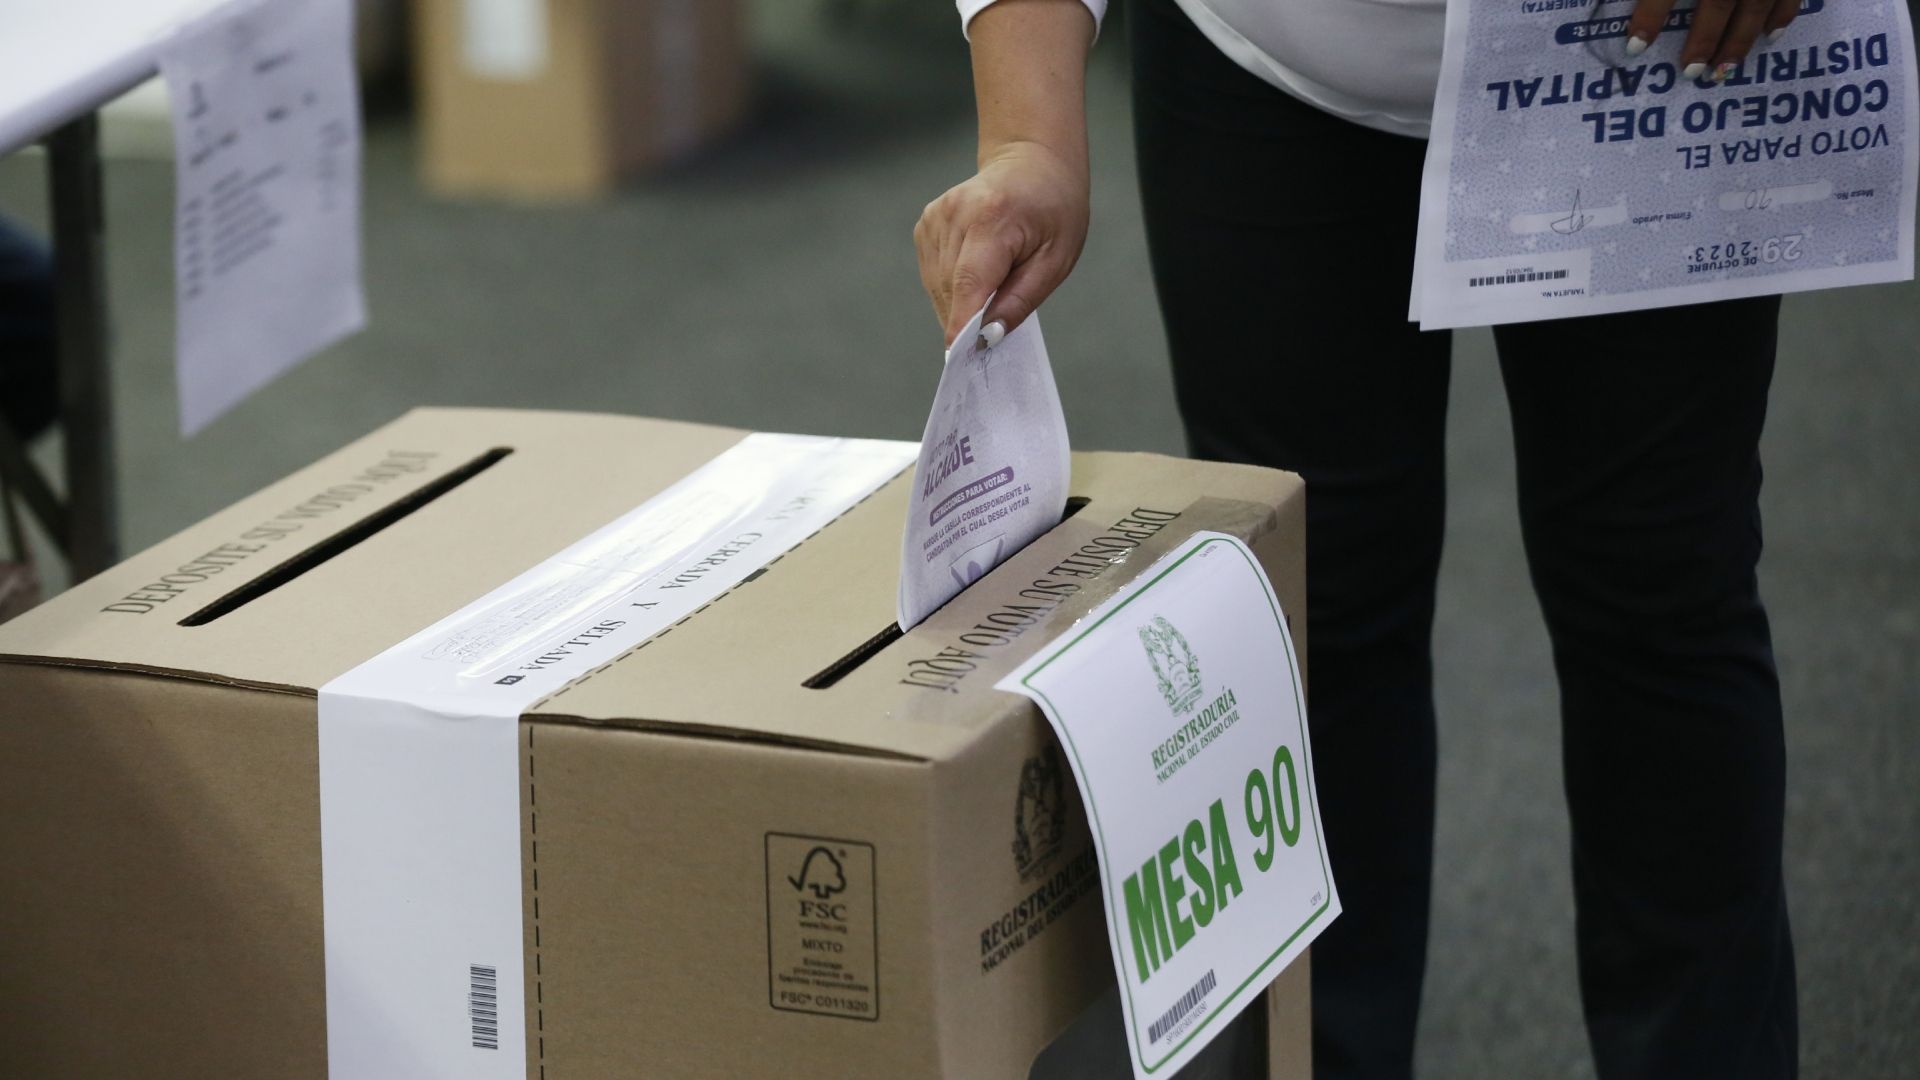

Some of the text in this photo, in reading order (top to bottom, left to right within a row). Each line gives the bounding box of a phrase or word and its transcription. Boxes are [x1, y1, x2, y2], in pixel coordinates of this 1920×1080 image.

[1573, 19, 1630, 37] VOTAR:
[1487, 62, 1676, 111] CAPITAL
[1582, 79, 1889, 143] CONCEJO DEL
[1676, 123, 1889, 169] VOTO PARA EL
[1834, 189, 1874, 200] Mesa No.
[1632, 211, 1692, 224] Firma Jurado
[1687, 257, 1757, 273] DE OCTUBRE
[1762, 233, 1803, 263] 29
[1553, 288, 1585, 297] TARJETA
[922, 435, 974, 502] ALCALDE
[965, 486, 983, 499] PARA
[983, 473, 1008, 490] VOTAR:
[939, 527, 945, 538] LA
[944, 516, 961, 533] CASILLA
[962, 486, 1022, 521] CORRESPONDIENTE
[1023, 483, 1031, 493] AL
[969, 519, 987, 531] CUAL
[987, 508, 1008, 523] DESEA
[1008, 496, 1029, 512] VOTAR
[100, 542, 267, 614] DEPOSITE
[240, 521, 303, 541] SU
[275, 484, 374, 519] VOTO
[659, 532, 763, 590] CERRADA
[1047, 507, 1182, 580] DEPOSITE
[631, 600, 659, 610] Y
[1019, 579, 1082, 610] SU
[519, 619, 627, 672] SELLADA
[960, 603, 1051, 647] VOTO
[1151, 685, 1237, 770] REGISTRADURÍA
[1156, 709, 1240, 785] NACIONAL DEL ESTADO CIVIL
[1123, 745, 1301, 984] MESA 90
[799, 899, 848, 921] FSC
[801, 937, 843, 953] MIXTO
[981, 933, 1025, 975] NACIONAL
[1027, 919, 1044, 941] DEL
